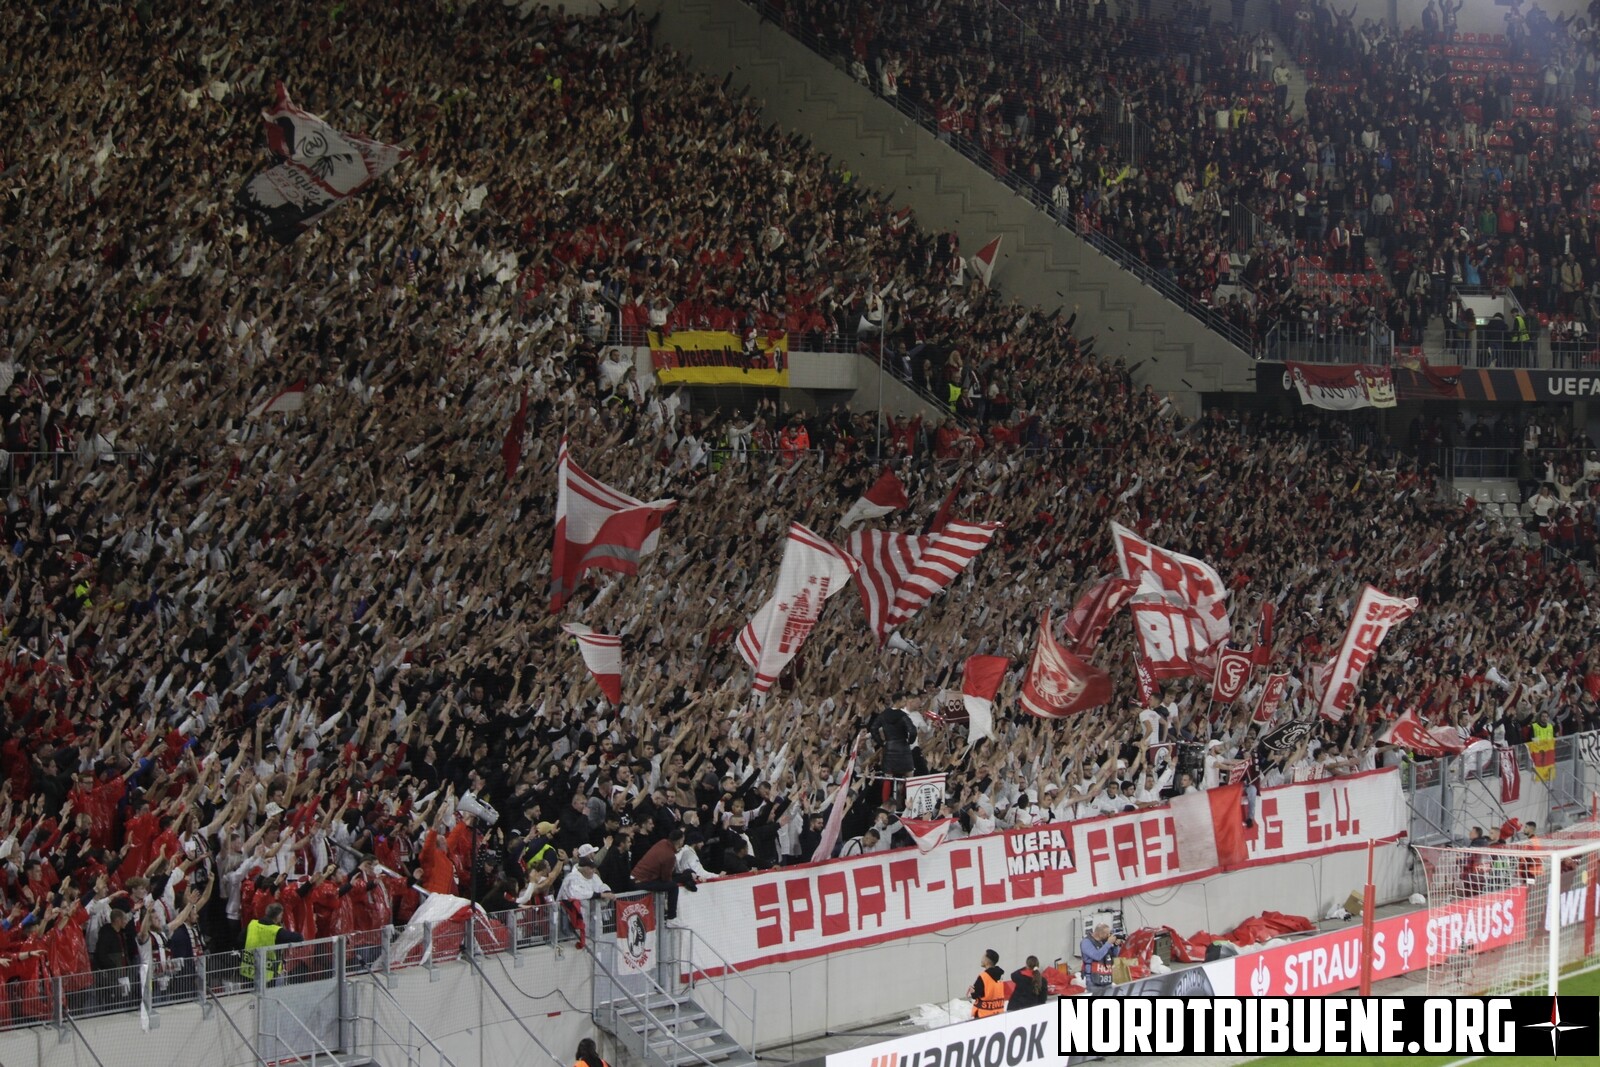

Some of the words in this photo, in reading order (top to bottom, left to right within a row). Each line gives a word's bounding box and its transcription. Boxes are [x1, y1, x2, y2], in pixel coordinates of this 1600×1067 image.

[675, 344, 724, 367] Dreisam
[1548, 377, 1600, 395] UEFA
[1305, 787, 1360, 844] E.V.
[1010, 829, 1067, 855] UEFA
[1007, 849, 1075, 876] MAFIA
[1284, 931, 1386, 995] STRAUS
[1425, 898, 1515, 957] STRAUSS
